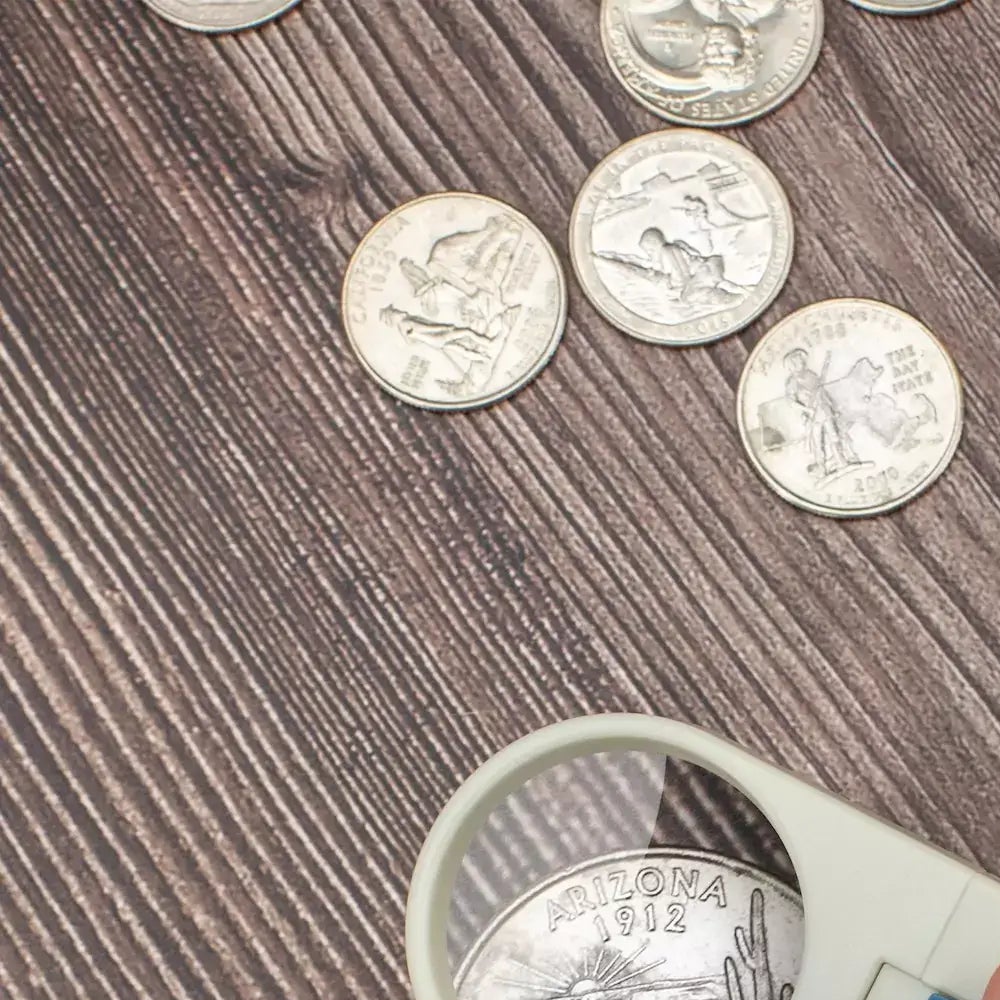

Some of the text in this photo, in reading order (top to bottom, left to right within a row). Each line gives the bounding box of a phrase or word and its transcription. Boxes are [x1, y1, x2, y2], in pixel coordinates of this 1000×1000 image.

[764, 36, 810, 97] UNITED
[691, 93, 759, 119] STATES
[545, 867, 728, 932] ARIZONA
[595, 902, 687, 943] 1912
